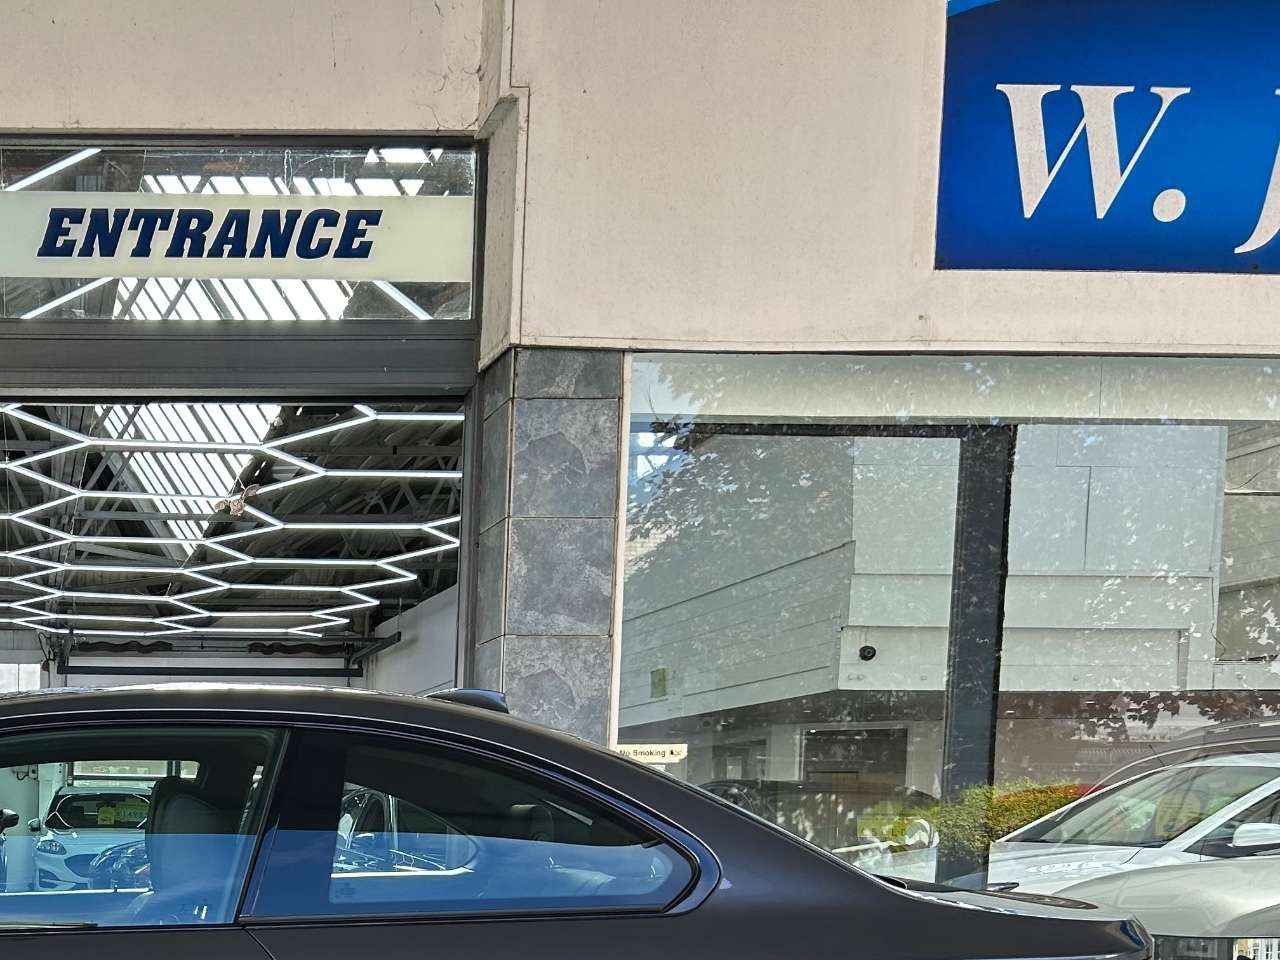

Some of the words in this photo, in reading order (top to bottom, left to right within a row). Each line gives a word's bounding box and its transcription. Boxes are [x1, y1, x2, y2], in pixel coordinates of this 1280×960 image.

[995, 83, 1192, 223] W.
[36, 207, 384, 260] ENTRANCE
[633, 749, 666, 758] Smoking
